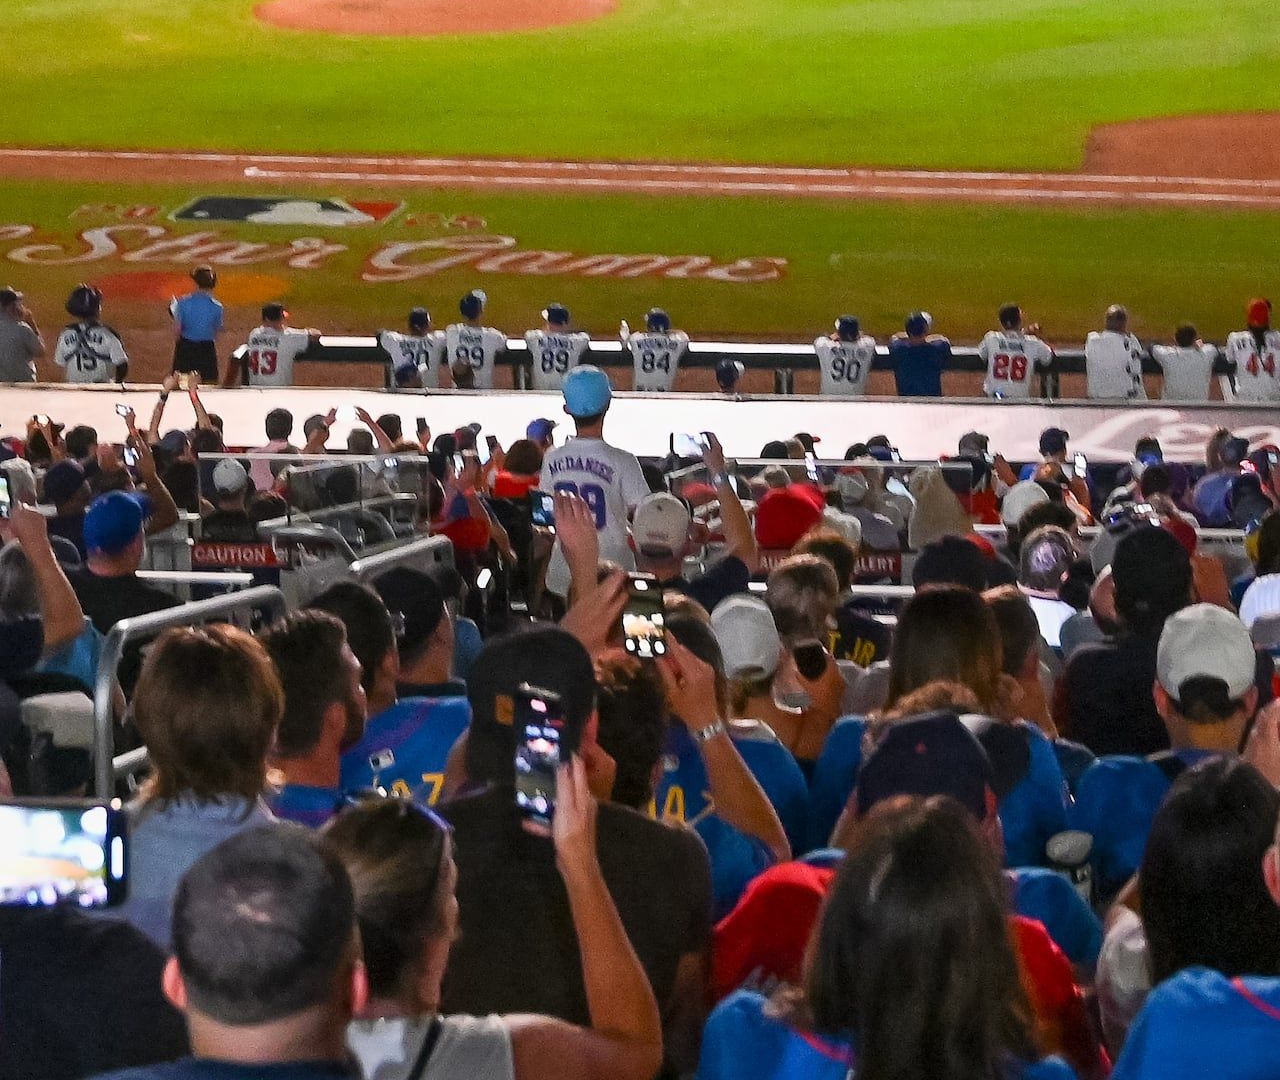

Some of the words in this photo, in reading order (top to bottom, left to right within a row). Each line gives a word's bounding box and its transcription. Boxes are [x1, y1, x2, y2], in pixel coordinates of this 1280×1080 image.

[361, 234, 788, 283] Game
[831, 358, 862, 384] 90
[193, 547, 267, 563] CAUTION
